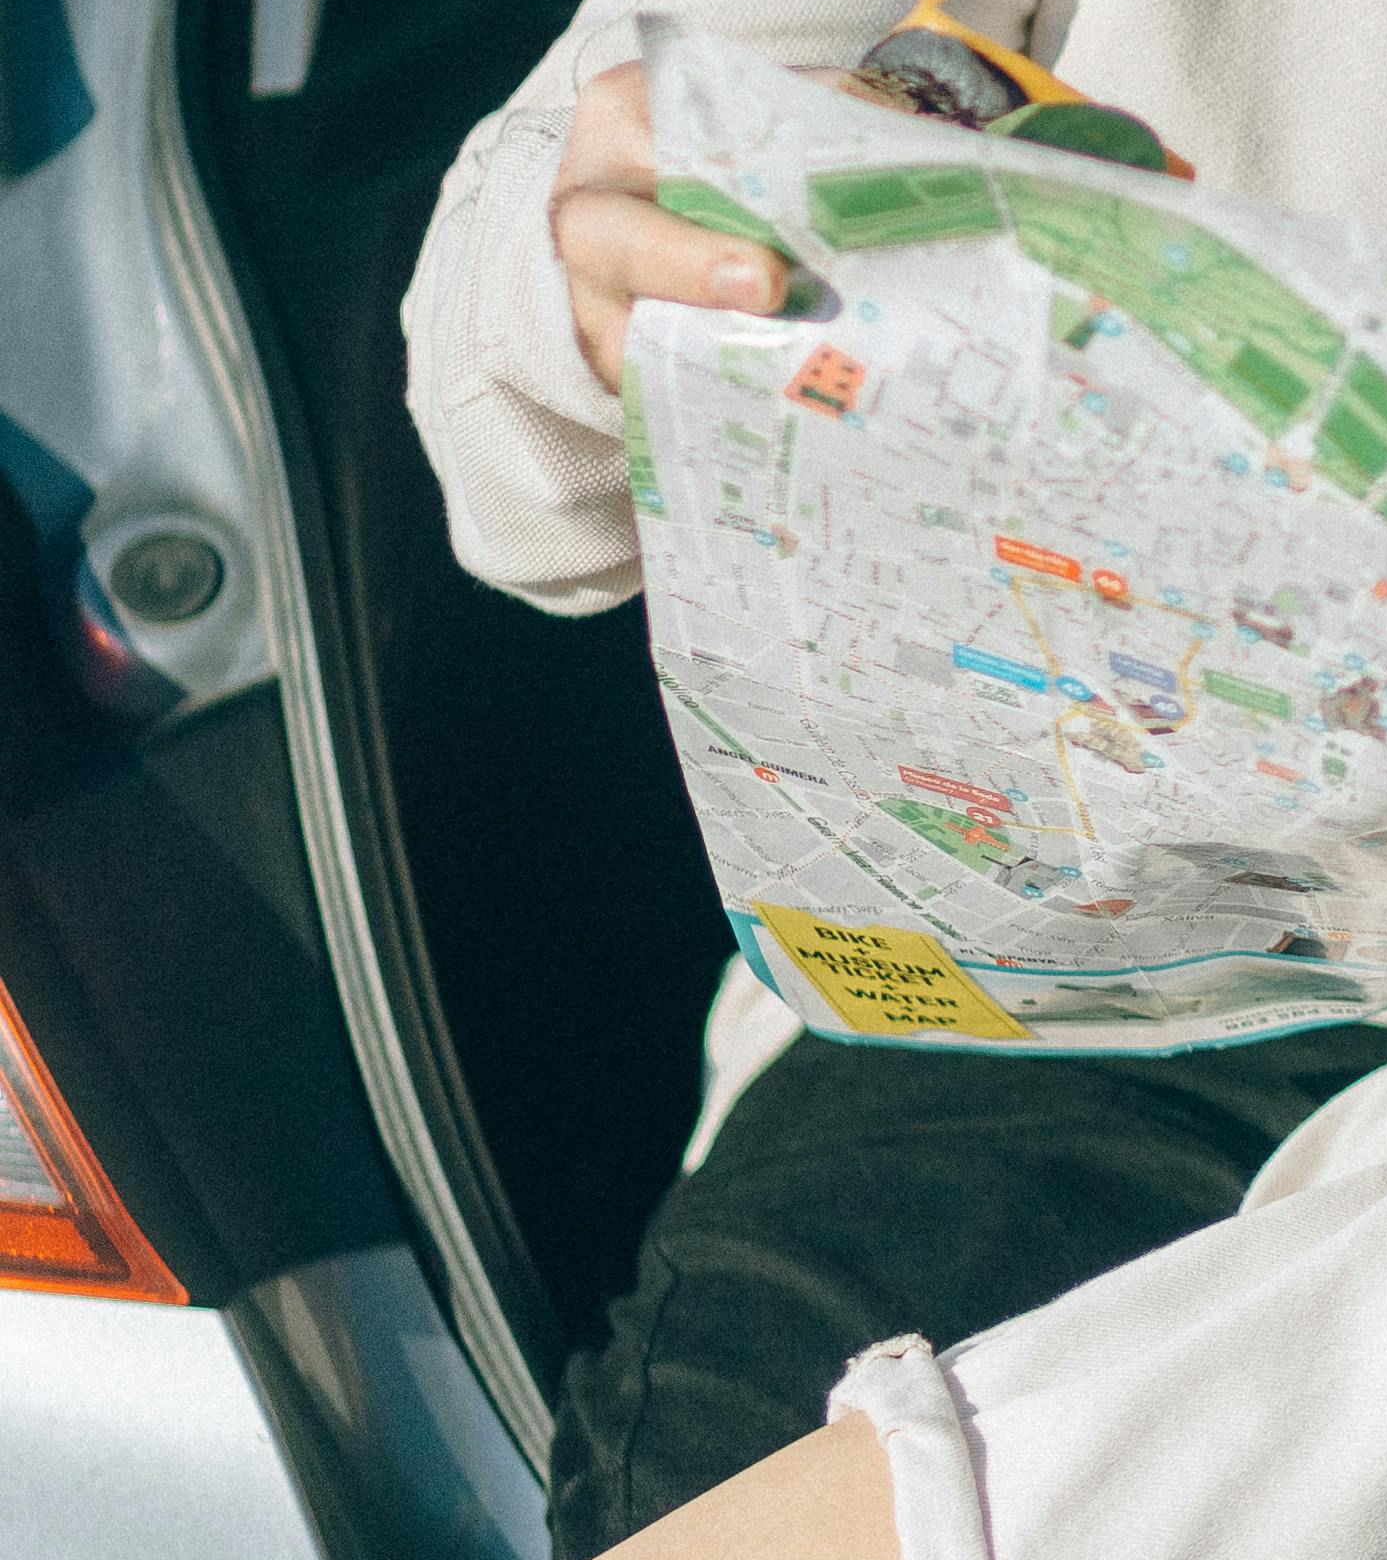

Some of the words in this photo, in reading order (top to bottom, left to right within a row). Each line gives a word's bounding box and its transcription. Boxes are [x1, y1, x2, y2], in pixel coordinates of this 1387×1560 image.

[813, 926, 894, 952] BIKE
[796, 946, 947, 978] MUSEUM
[821, 963, 935, 986] TICKET
[844, 987, 960, 1008] WATER
[883, 1011, 958, 1026] MAP
